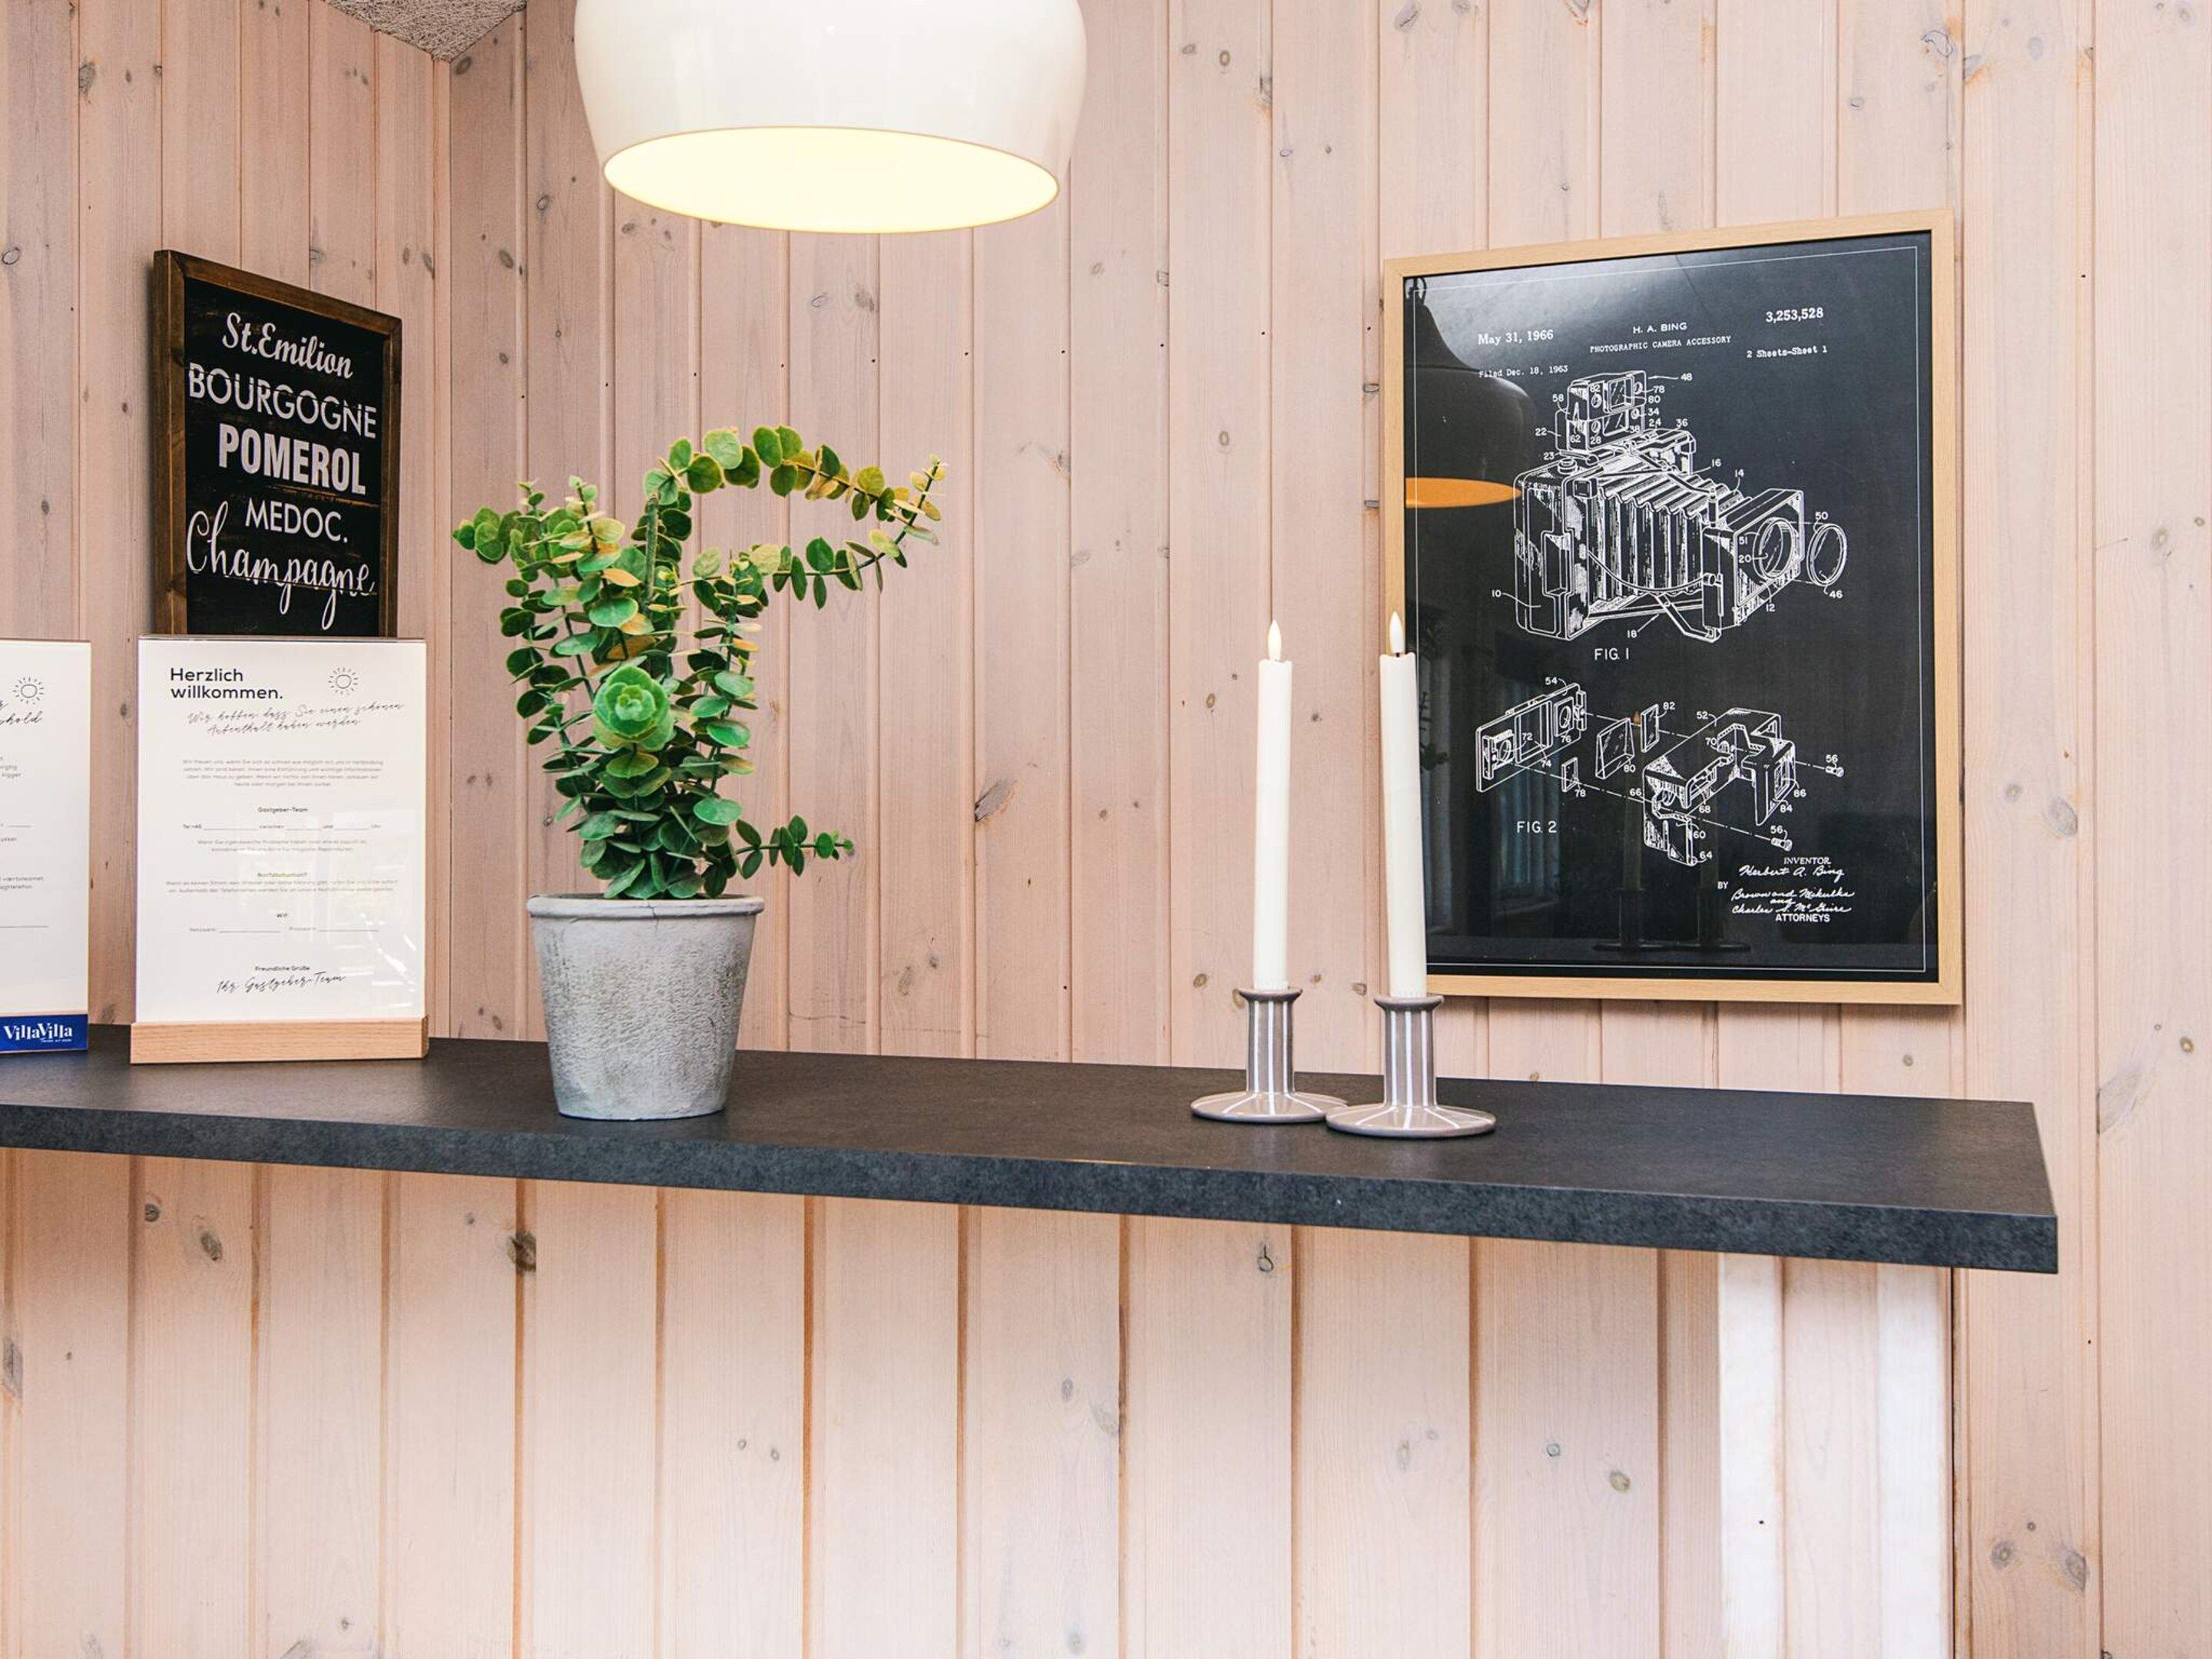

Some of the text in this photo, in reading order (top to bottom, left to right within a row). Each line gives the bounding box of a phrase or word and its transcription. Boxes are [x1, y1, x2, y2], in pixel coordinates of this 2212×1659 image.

[1765, 306, 1824, 323] 3,253,528
[1632, 326, 1644, 334] H.
[1660, 322, 1687, 332] BING
[1478, 329, 1554, 346] May 31, 1966
[221, 312, 353, 379] St.Emilion
[1589, 336, 1732, 353] PHOTOGRAPHIC CAMERA ACCESSORY
[1746, 345, 1827, 358] 2 Sheets-Sheet 1
[1479, 365, 1568, 379] Filed Dec. 18, 1963
[1681, 373, 1694, 382] 48
[1589, 384, 1601, 393] 82
[1653, 386, 1665, 394] 78
[188, 362, 377, 439] BOURGOGNE
[1552, 393, 1564, 402] 58
[1648, 395, 1661, 404] 80
[1648, 407, 1660, 416] 34
[1648, 418, 1662, 427] 24
[1676, 418, 1689, 427] 36
[1535, 427, 1548, 436] 22
[1629, 425, 1641, 434] 38
[1570, 435, 1581, 444] 62
[1590, 435, 1601, 445] 28
[218, 422, 366, 495] POMEROL
[1543, 452, 1555, 461] 23
[1711, 458, 1722, 468] 16
[1734, 469, 1745, 478] 14
[244, 497, 348, 543] MEDOC.
[1815, 511, 1829, 521] 50
[1738, 554, 1752, 563] 20
[186, 501, 376, 631] Champagne
[1491, 589, 1502, 598] 10
[1829, 589, 1843, 599] 46
[1765, 603, 1776, 612] 12
[1626, 629, 1638, 638] 18
[1594, 647, 1630, 661] FIG. 1
[171, 667, 243, 682] Herzlich
[1545, 676, 1558, 685] 54
[171, 684, 283, 700] willkommen.
[1663, 700, 1676, 710] 82
[1696, 710, 1709, 720] 52
[1522, 732, 1533, 741] 72
[1560, 734, 1572, 743] 76
[1705, 737, 1717, 746] 70
[1541, 759, 1552, 768] 74
[1825, 754, 1838, 763] 56
[1624, 763, 1636, 773] 80
[1575, 788, 1587, 798] 78
[1630, 787, 1642, 796] 66
[1793, 788, 1806, 798] 86
[1699, 804, 1711, 814] 68
[1780, 803, 1793, 813] 84
[1516, 820, 1558, 833] FIG. 2
[1770, 825, 1783, 835] 56
[1693, 830, 1706, 839] 60
[1699, 850, 1713, 859] 64
[1738, 864, 1845, 883] Herbert A. Bing
[1717, 881, 1729, 889] BY
[1731, 903, 1773, 914] Charles
[1775, 913, 1831, 922] ATTORNEYS
[3, 1022, 73, 1041] VillaVilla
